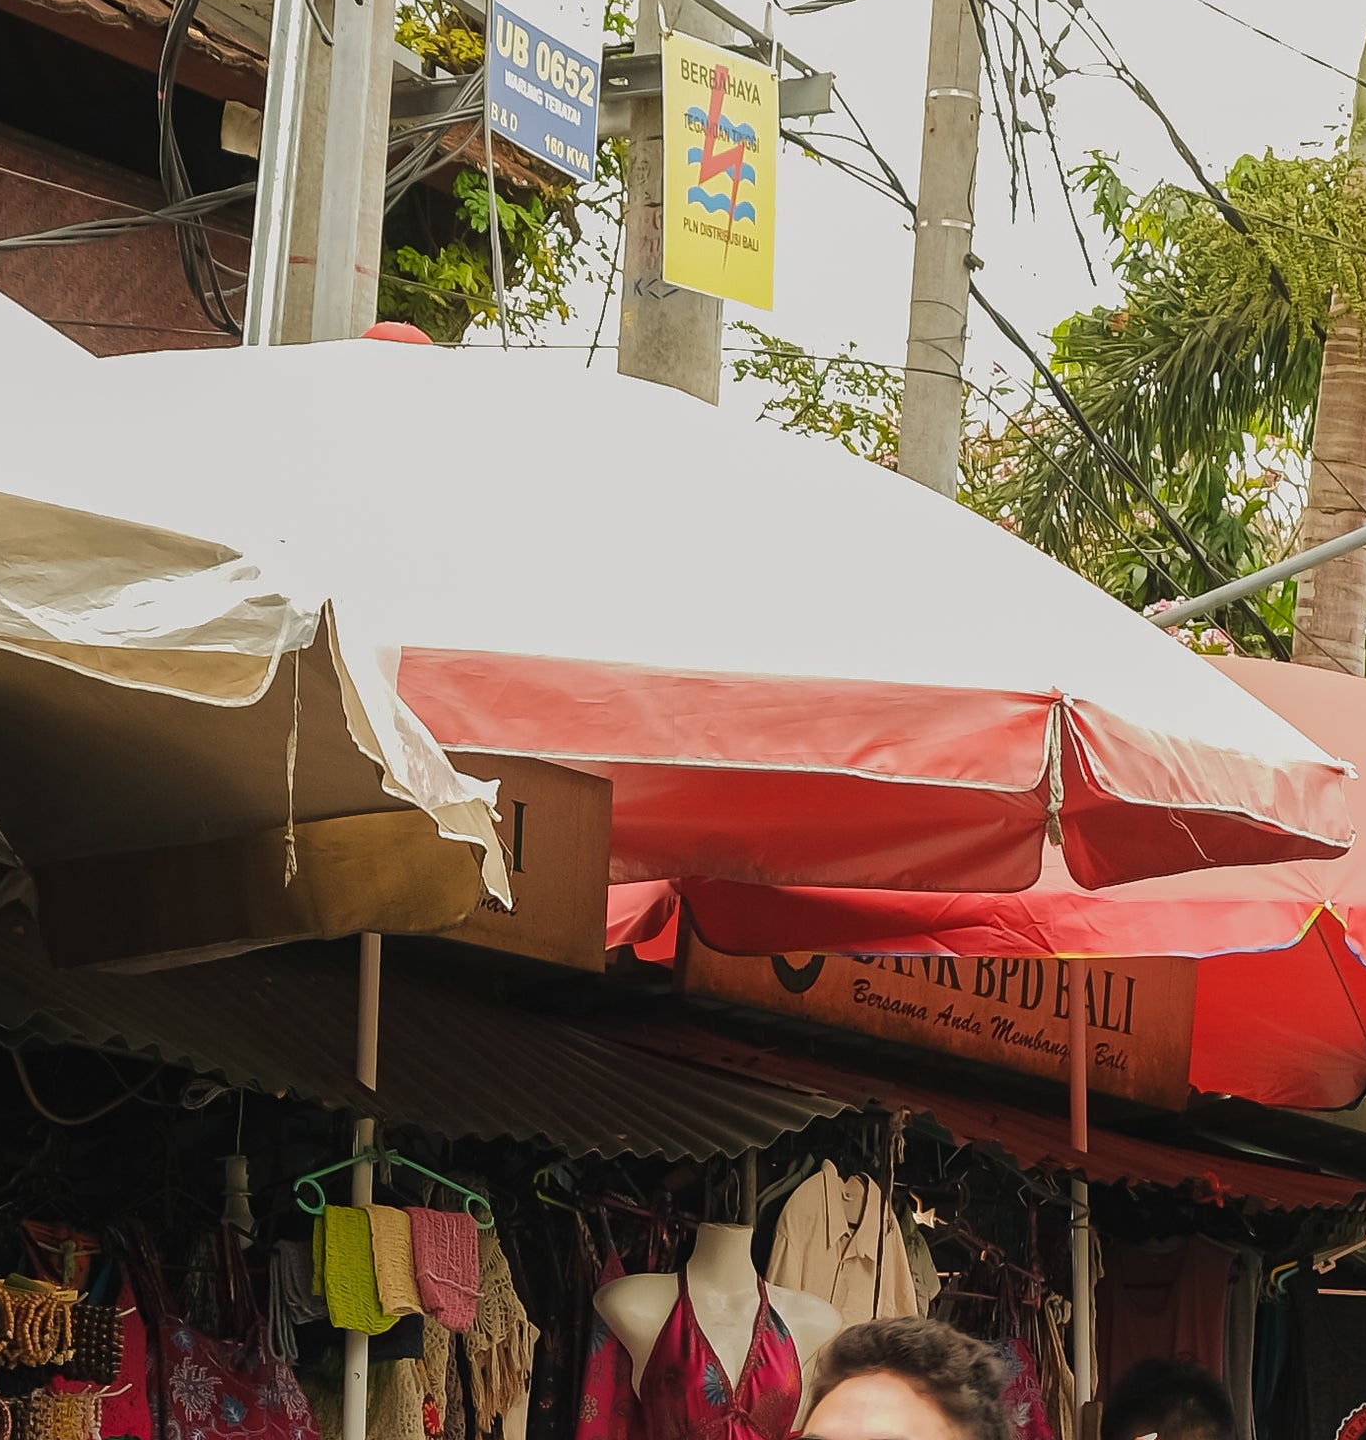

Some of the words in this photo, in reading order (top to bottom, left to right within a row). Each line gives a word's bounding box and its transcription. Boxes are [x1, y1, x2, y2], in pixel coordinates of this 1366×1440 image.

[496, 14, 530, 68] UB
[535, 40, 595, 107] 0652
[680, 57, 761, 106] BERBAHAYA
[491, 101, 499, 122] B
[510, 112, 518, 132] D
[544, 133, 564, 159] 160
[566, 145, 590, 173] KVA
[683, 216, 698, 234] PLN
[700, 222, 741, 247] DISTRIBUSI
[742, 234, 759, 252] BALI
[971, 956, 1044, 1010] BPD
[852, 978, 929, 1021] Bersama
[933, 1004, 983, 1036] Anda
[1094, 1042, 1130, 1072] Bali
